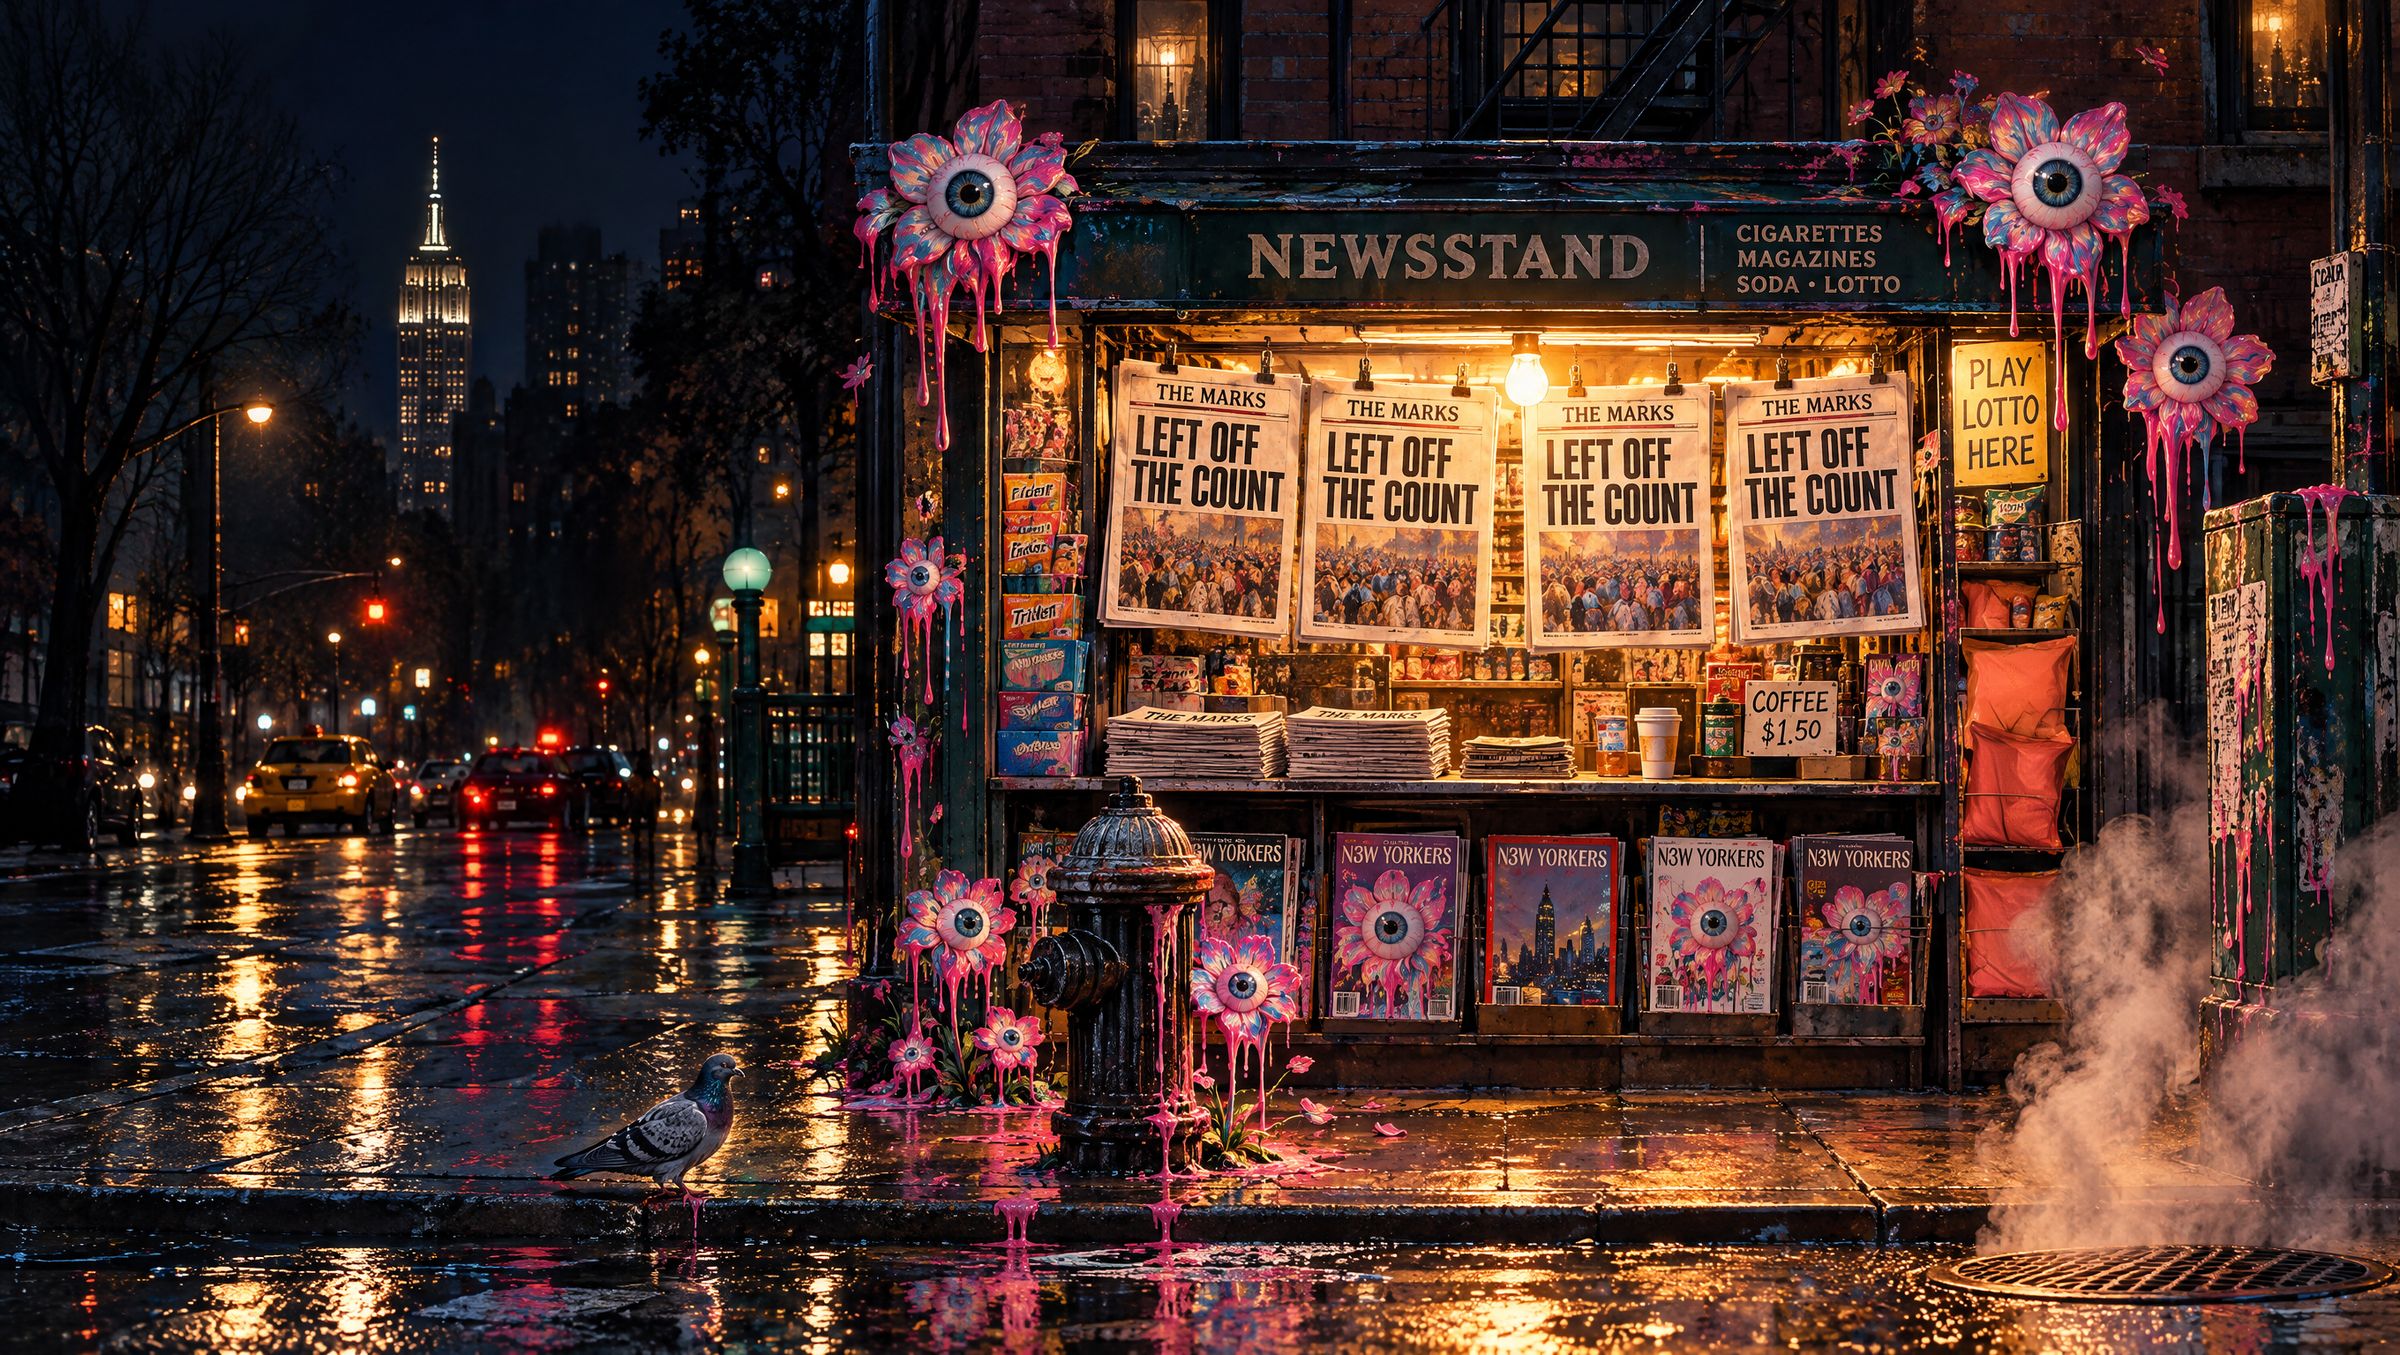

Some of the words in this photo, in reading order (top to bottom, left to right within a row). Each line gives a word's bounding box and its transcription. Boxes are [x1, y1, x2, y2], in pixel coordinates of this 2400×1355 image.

[1737, 224, 1882, 243] CIGARETTES
[1248, 233, 1649, 280] NEWSSTAND
[1737, 249, 1877, 269] MAGAZINES
[1736, 275, 1800, 294] SODA
[1824, 275, 1901, 294] LOTTO
[1969, 356, 2033, 389] PLAY
[1157, 384, 1194, 402] THE
[1200, 387, 1266, 409] MARKS
[1762, 399, 1800, 416] THE
[1807, 394, 1872, 413] MARKS
[1348, 399, 1385, 418] THE
[1391, 402, 1459, 422] MARKS
[1563, 406, 1600, 423] THE
[1608, 405, 1674, 422] MARKS
[1962, 394, 2039, 429] LOTTO
[1135, 415, 1202, 459] LEFT
[1210, 422, 1260, 465] OFF
[1747, 430, 1812, 474] LEFT
[1821, 426, 1870, 468] OFF
[1327, 432, 1393, 475] LEFT
[1401, 435, 1453, 478] OFF
[1547, 438, 1613, 480] LEFT
[1623, 438, 1671, 478] OFF
[1968, 435, 2035, 470] HERE
[1131, 459, 1183, 505] THE
[1191, 465, 1285, 512] COUNT
[1745, 476, 1798, 519] THE
[1805, 469, 1898, 515] COUNT
[1322, 476, 1374, 520] THE
[1384, 480, 1479, 524] COUNT
[1542, 484, 1595, 525] THE
[1604, 483, 1697, 525] COUNT
[1753, 690, 1828, 713] COFFEE
[1145, 711, 1181, 722] THE
[1189, 715, 1256, 723] MARKS
[1319, 710, 1355, 720] THE
[1357, 712, 1421, 720] MARKS
[1762, 718, 1821, 746] $1.50
[1218, 844, 1282, 862] YORKERS
[1342, 845, 1378, 864] N3W
[1383, 846, 1452, 864] YORKERS
[1498, 847, 1534, 866] N3W
[1538, 848, 1607, 868] YORKERS
[1658, 848, 1693, 866] N3W
[1696, 848, 1764, 868] YORKERS
[1808, 849, 1840, 867] N3W
[1845, 851, 1910, 868] YORKERS
